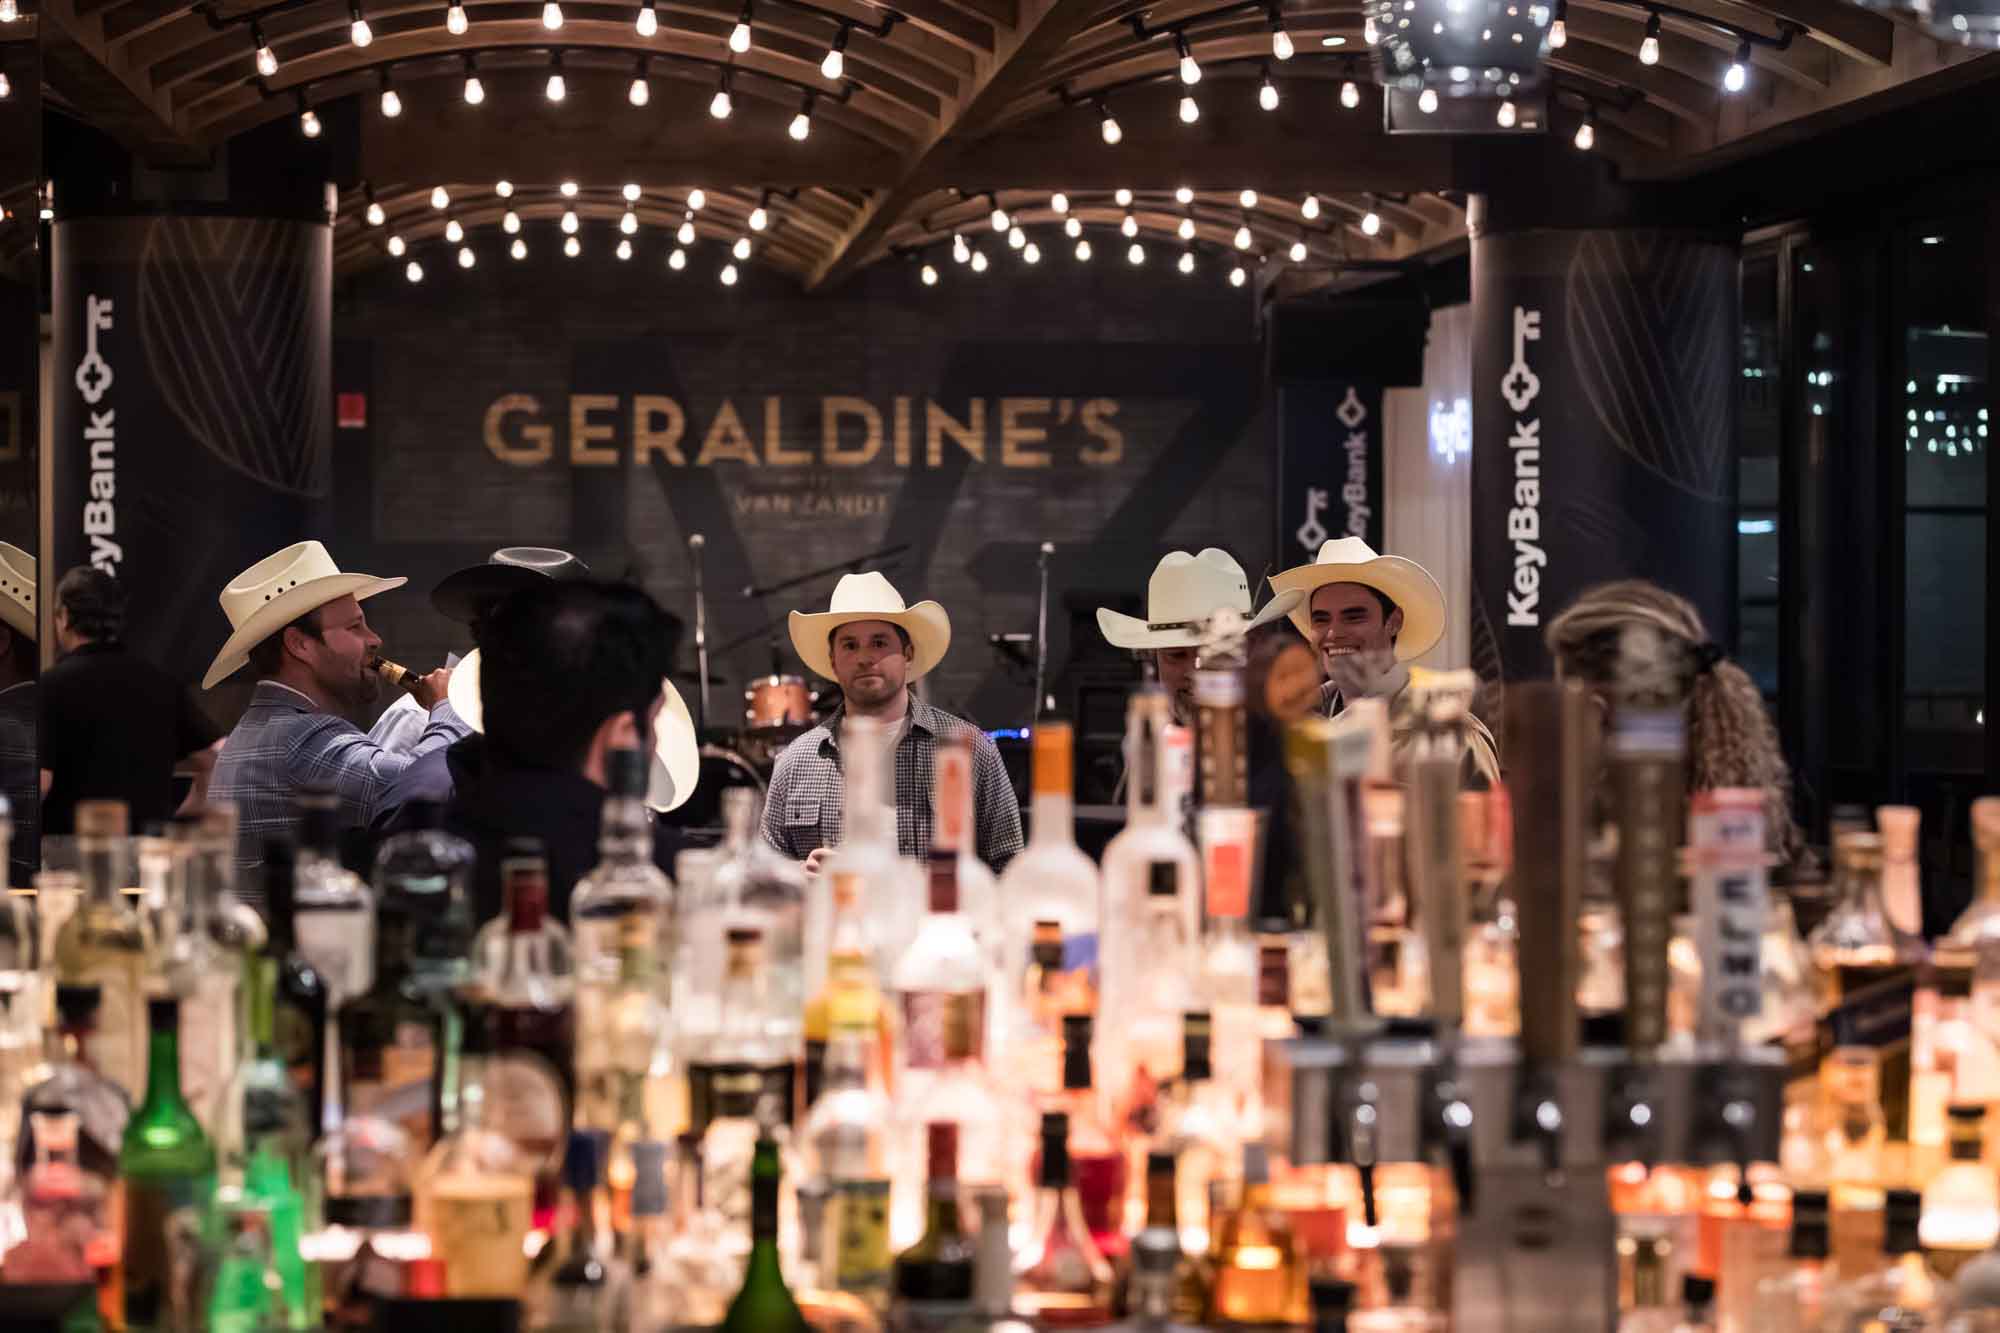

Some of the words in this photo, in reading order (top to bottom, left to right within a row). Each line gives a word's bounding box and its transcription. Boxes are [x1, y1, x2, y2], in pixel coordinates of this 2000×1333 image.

[483, 393, 1124, 468] GERALDINE'S
[84, 409, 122, 577] yBank
[735, 494, 792, 514] VAN
[1507, 418, 1547, 626] KeyBank
